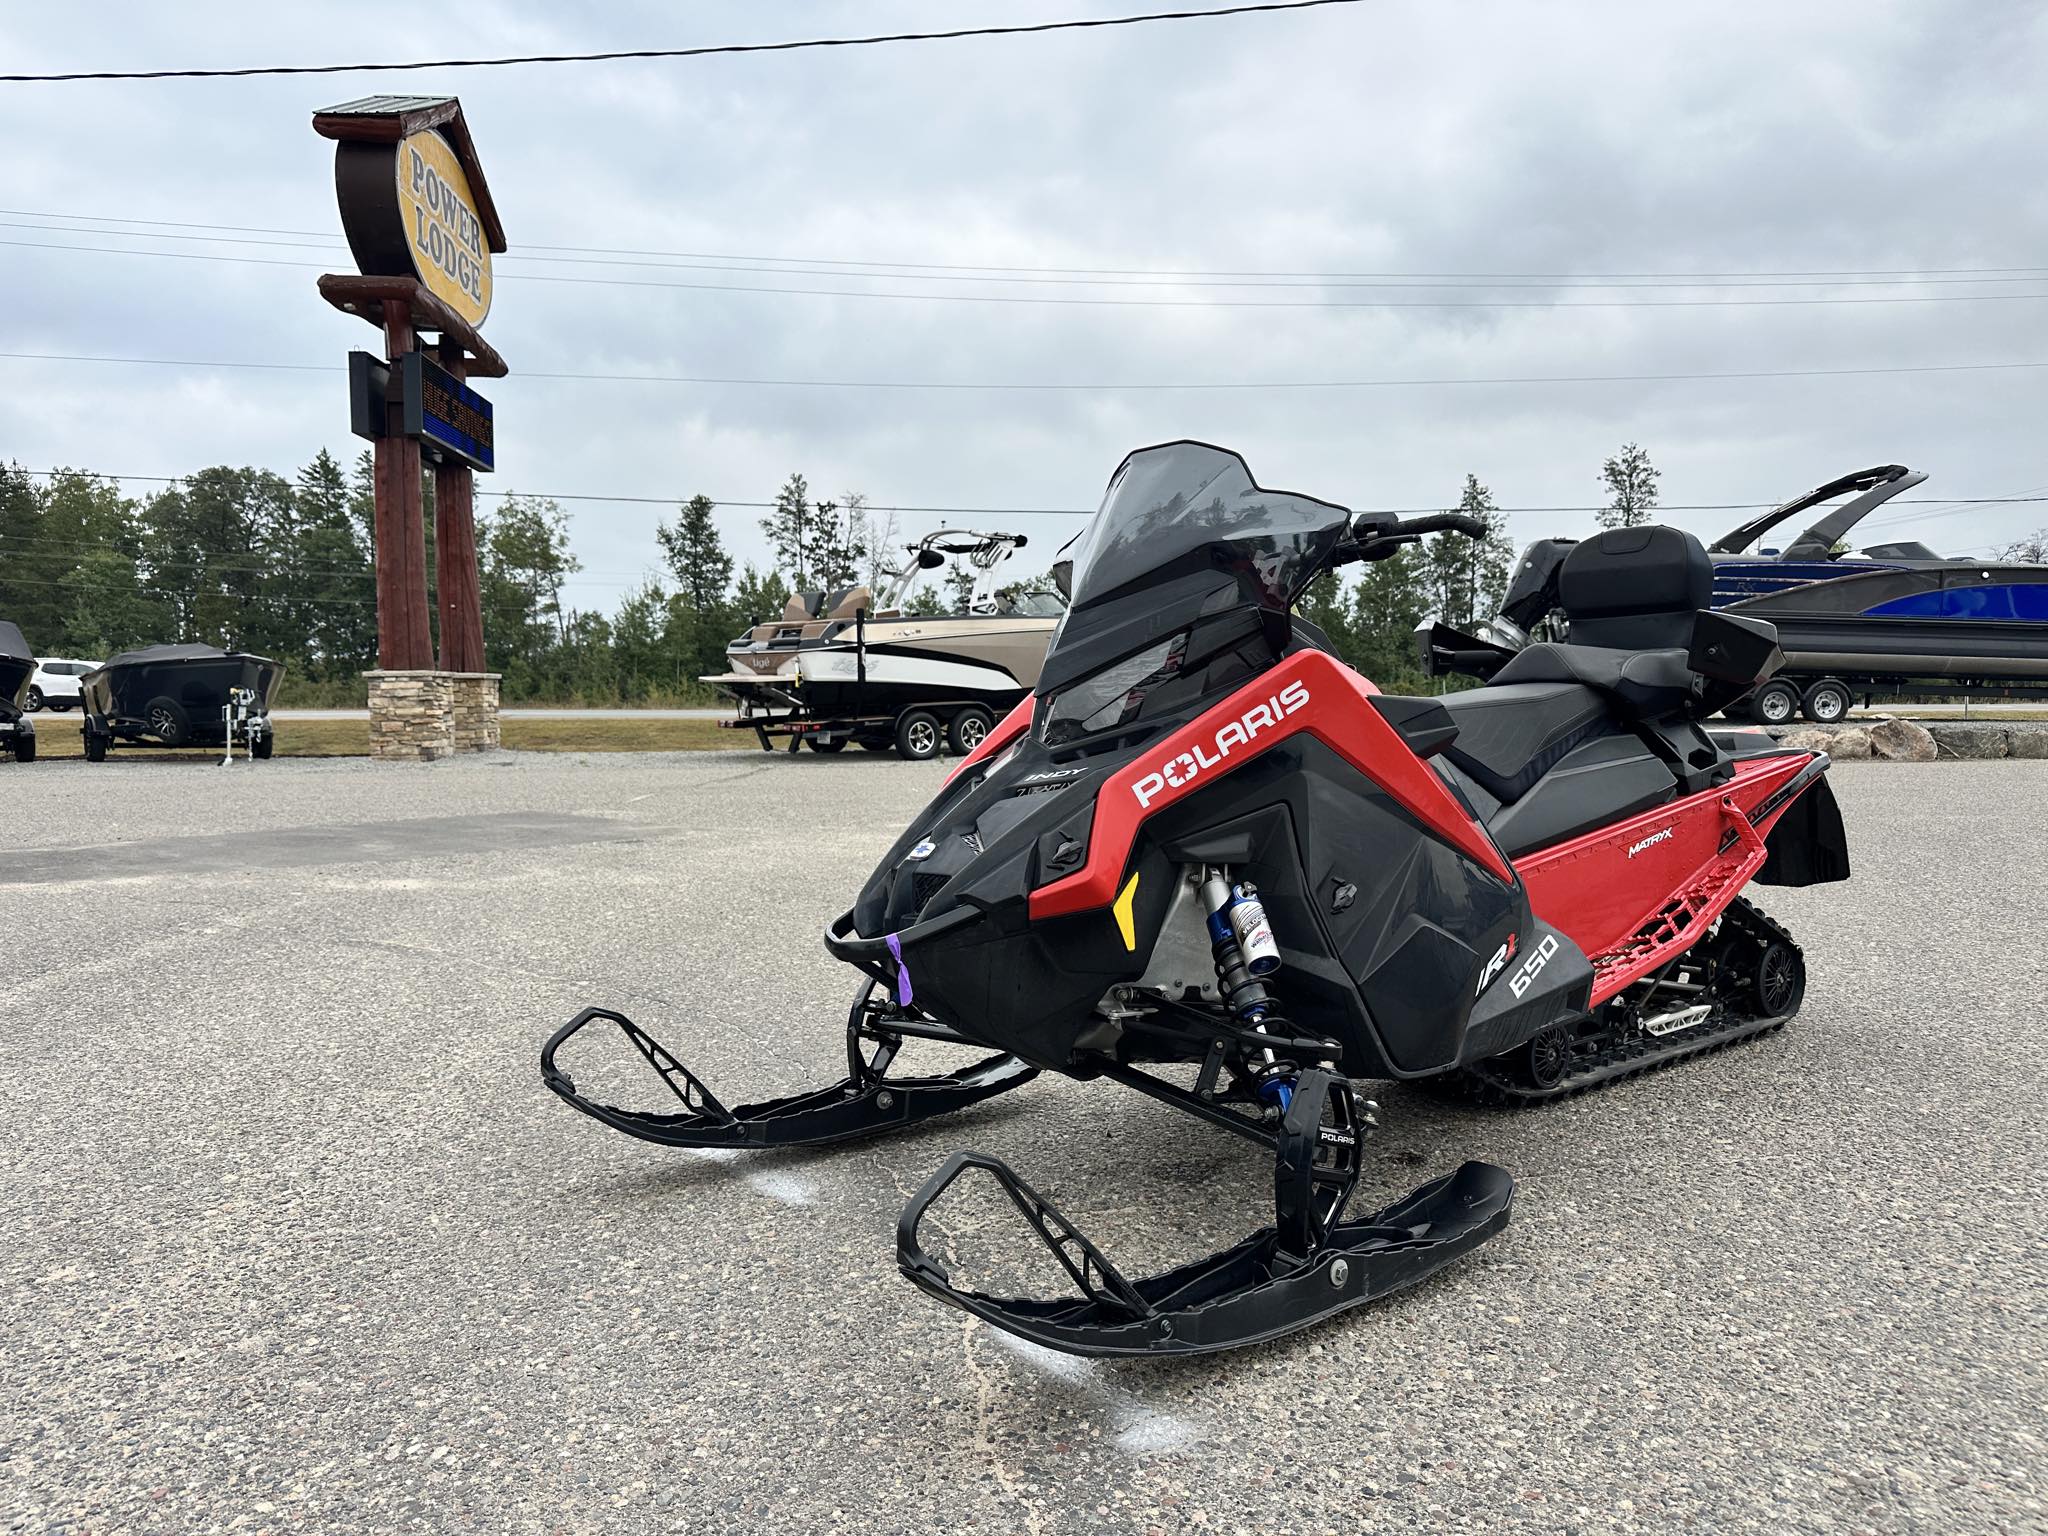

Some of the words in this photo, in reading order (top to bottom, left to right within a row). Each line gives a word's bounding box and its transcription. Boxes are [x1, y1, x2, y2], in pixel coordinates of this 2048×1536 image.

[411, 148, 482, 260] POWER
[415, 205, 481, 303] LODGE
[1024, 767, 1089, 782] INDY
[1131, 680, 1310, 808] POLARIS
[1628, 826, 1673, 859] MATRYX
[1508, 934, 1560, 1000] 650
[1321, 1132, 1355, 1145] POLARIS
